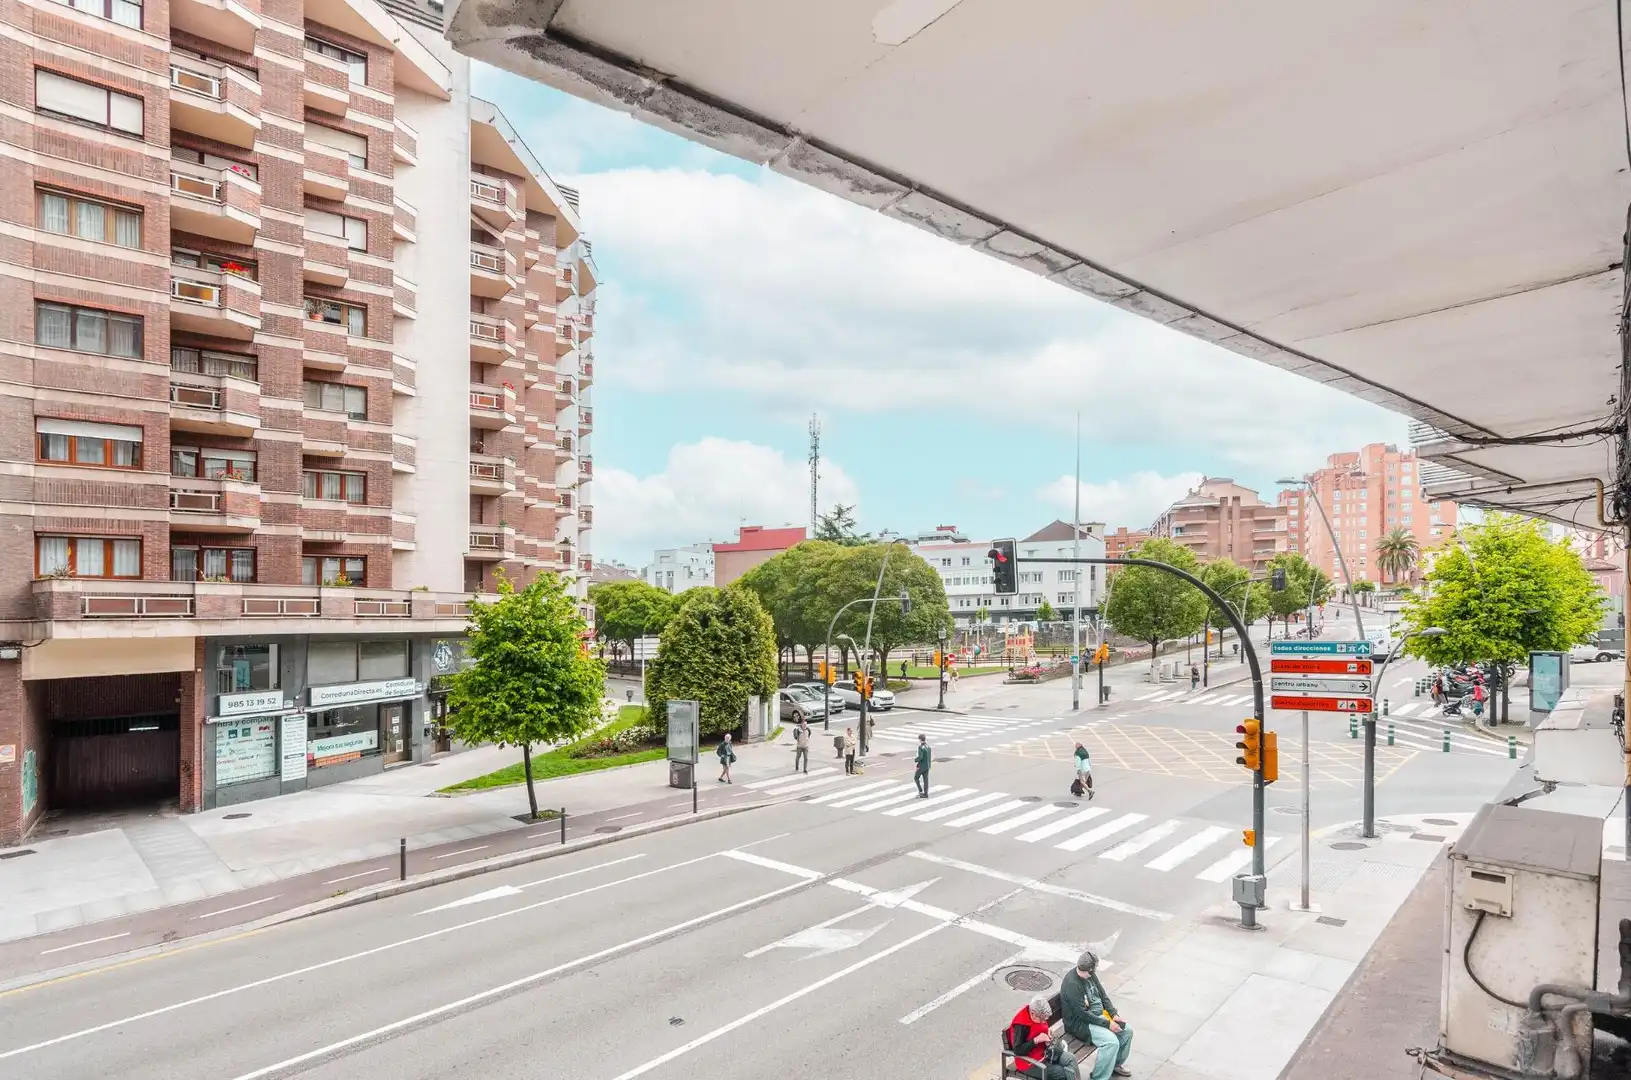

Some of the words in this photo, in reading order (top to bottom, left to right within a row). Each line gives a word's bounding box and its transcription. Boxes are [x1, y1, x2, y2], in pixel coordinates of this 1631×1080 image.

[227, 700, 244, 709] 985
[246, 699, 255, 707] 13
[257, 698, 265, 706] 19
[267, 697, 277, 705] 52
[242, 715, 274, 726] compara
[316, 743, 335, 752] Mejora
